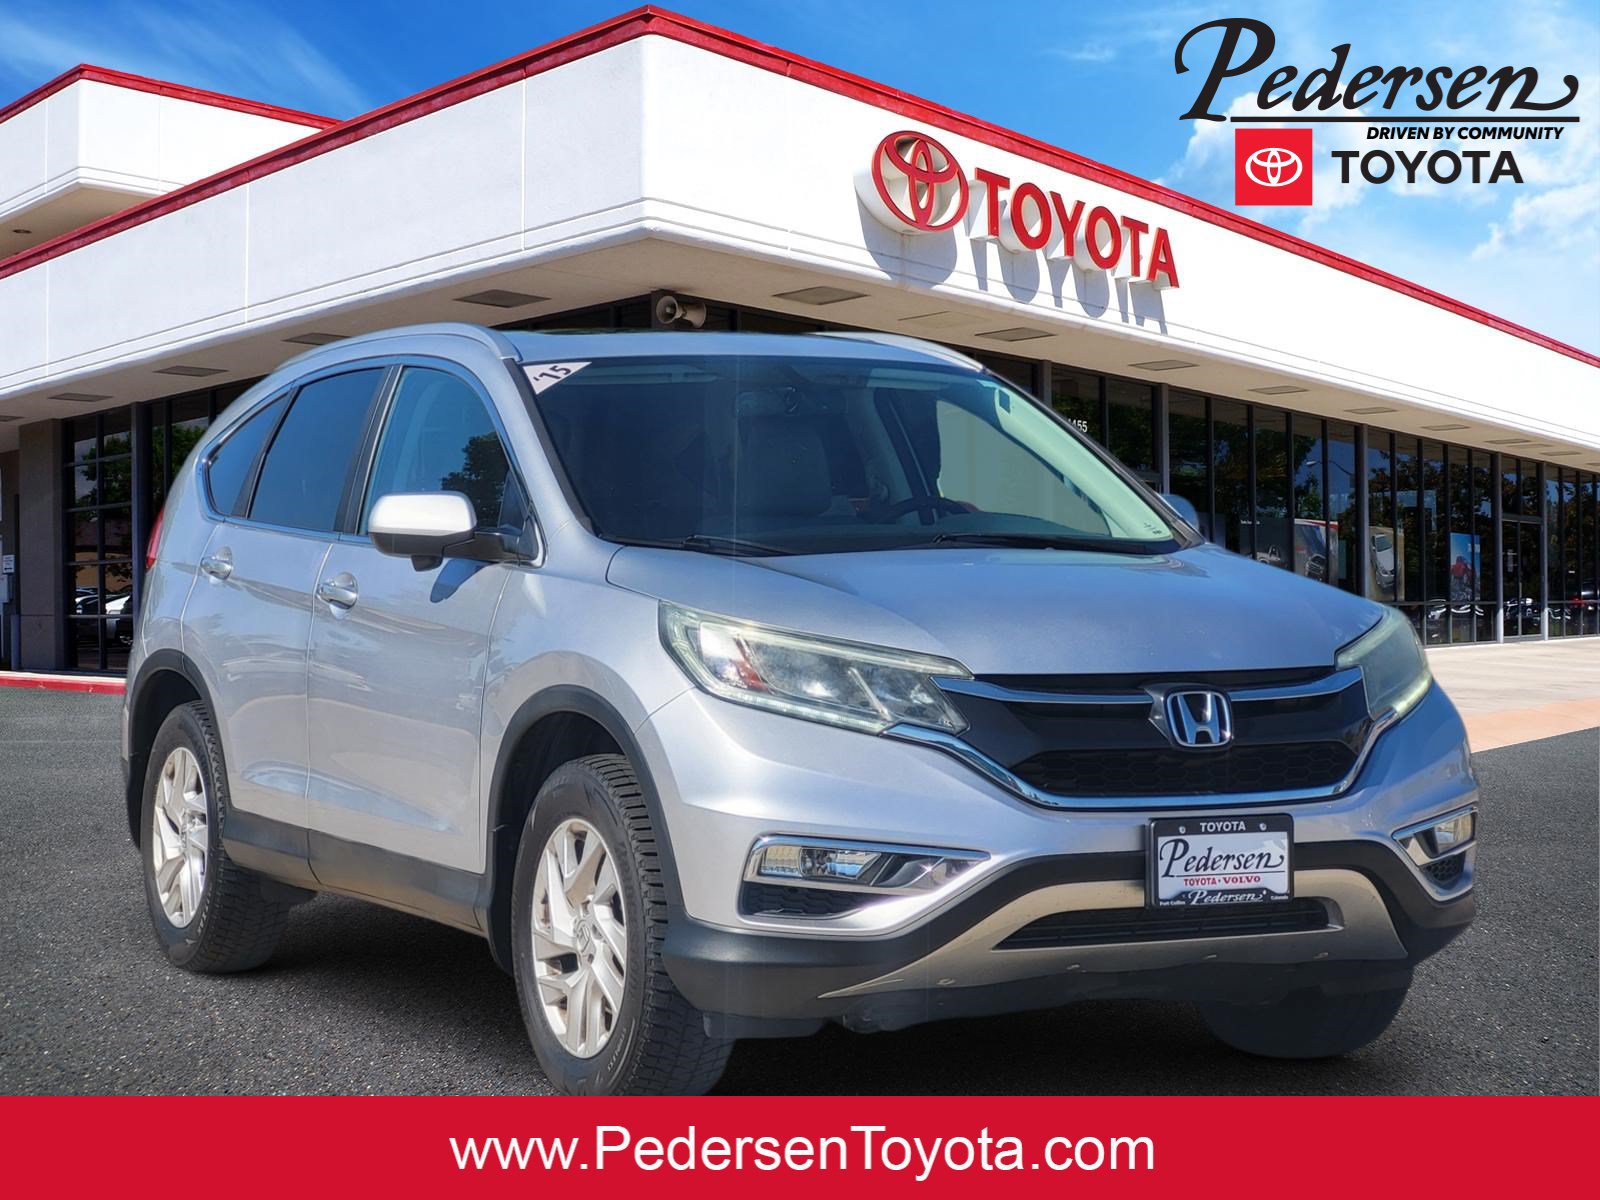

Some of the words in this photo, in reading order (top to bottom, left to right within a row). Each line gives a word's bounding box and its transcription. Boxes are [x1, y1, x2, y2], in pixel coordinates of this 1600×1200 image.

[975, 167, 1180, 289] TOYOTA
[1200, 821, 1246, 833] TOYOTA
[1159, 838, 1285, 878] Pedersen
[1184, 877, 1217, 887] TOYOTA
[1222, 875, 1261, 885] VOLVO
[1188, 890, 1263, 905] Pedersen
